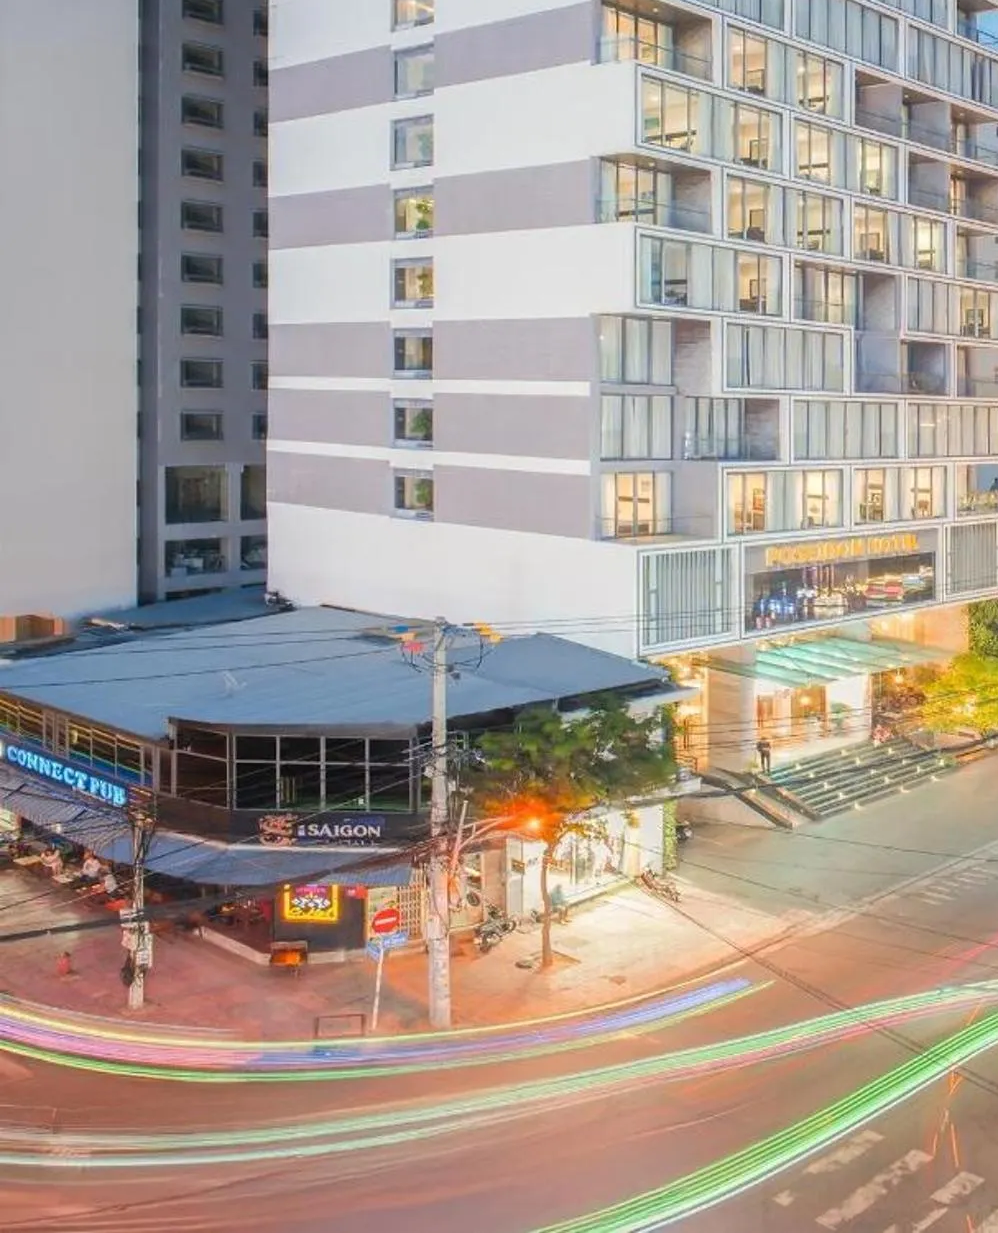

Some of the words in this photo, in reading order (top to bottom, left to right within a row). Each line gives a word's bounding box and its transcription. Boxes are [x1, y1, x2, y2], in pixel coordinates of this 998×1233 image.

[7, 746, 87, 790] CONNECT
[90, 777, 126, 807] PUB
[307, 824, 381, 838] SAIGON
